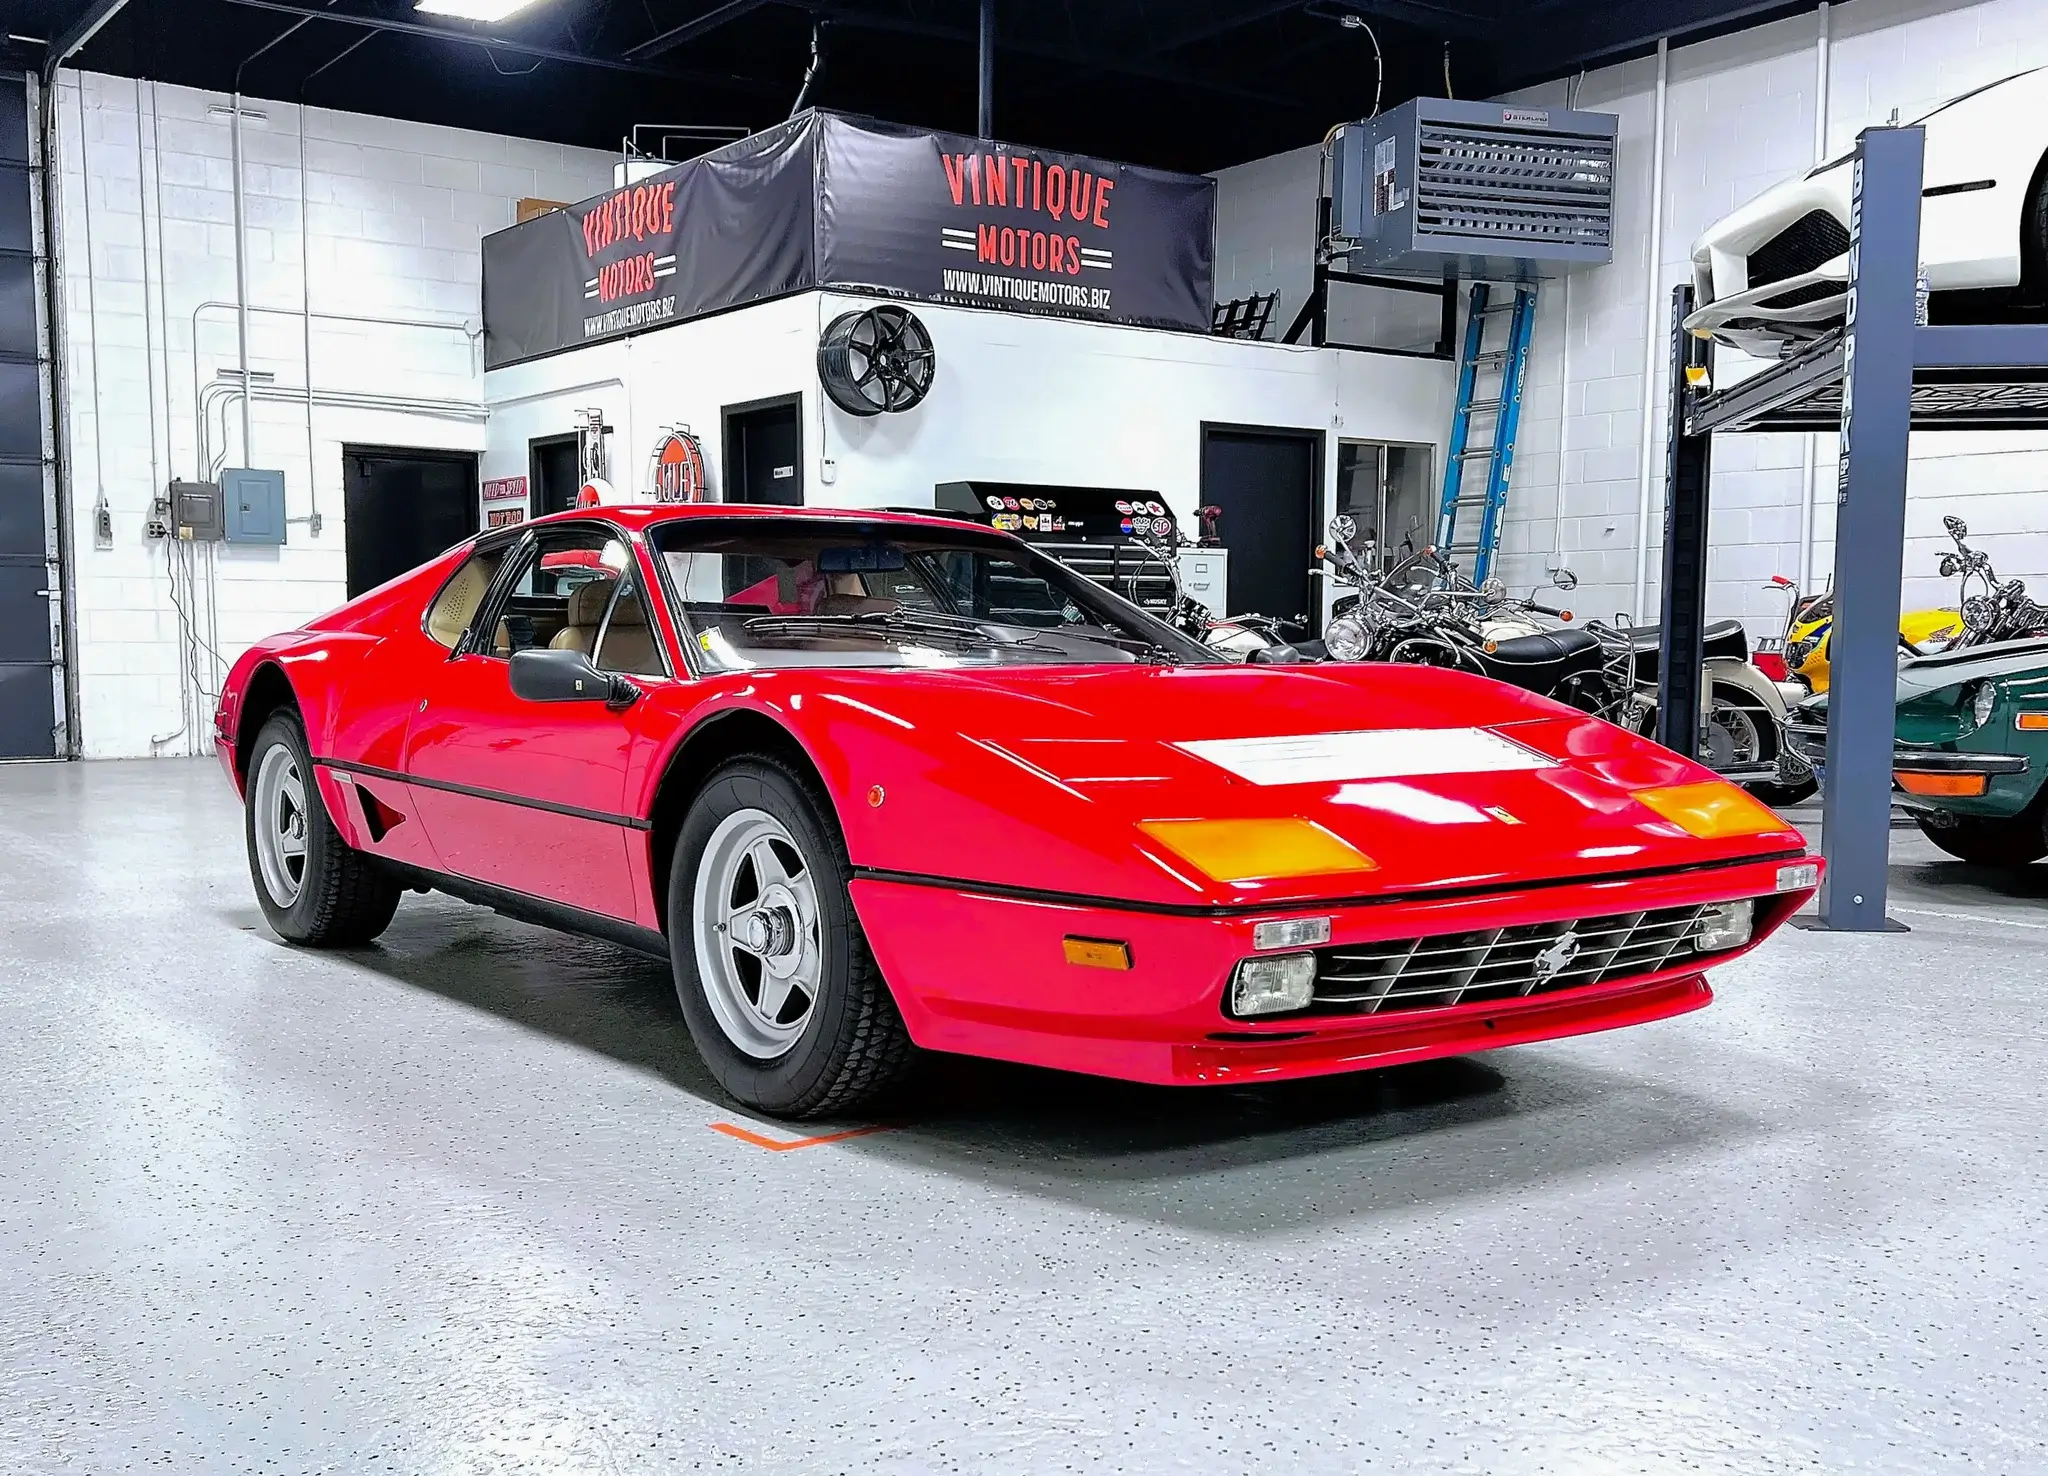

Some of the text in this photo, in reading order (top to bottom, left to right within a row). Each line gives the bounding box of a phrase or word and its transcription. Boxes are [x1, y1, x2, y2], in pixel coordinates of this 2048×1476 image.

[942, 154, 1115, 229] VINTIQUE
[583, 182, 675, 258] VINTIQUE
[978, 223, 1080, 275] MOTORS
[599, 251, 655, 304] MOTORS
[943, 268, 1111, 310] WWW.VINTIQUEMOTORS.BIZ
[584, 295, 676, 338] WWW.VINTIQUEMOTORS.BIZ
[1840, 158, 1864, 454] BENDPAK
[489, 510, 522, 526] HOT ROD
[1154, 520, 1168, 532] STP
